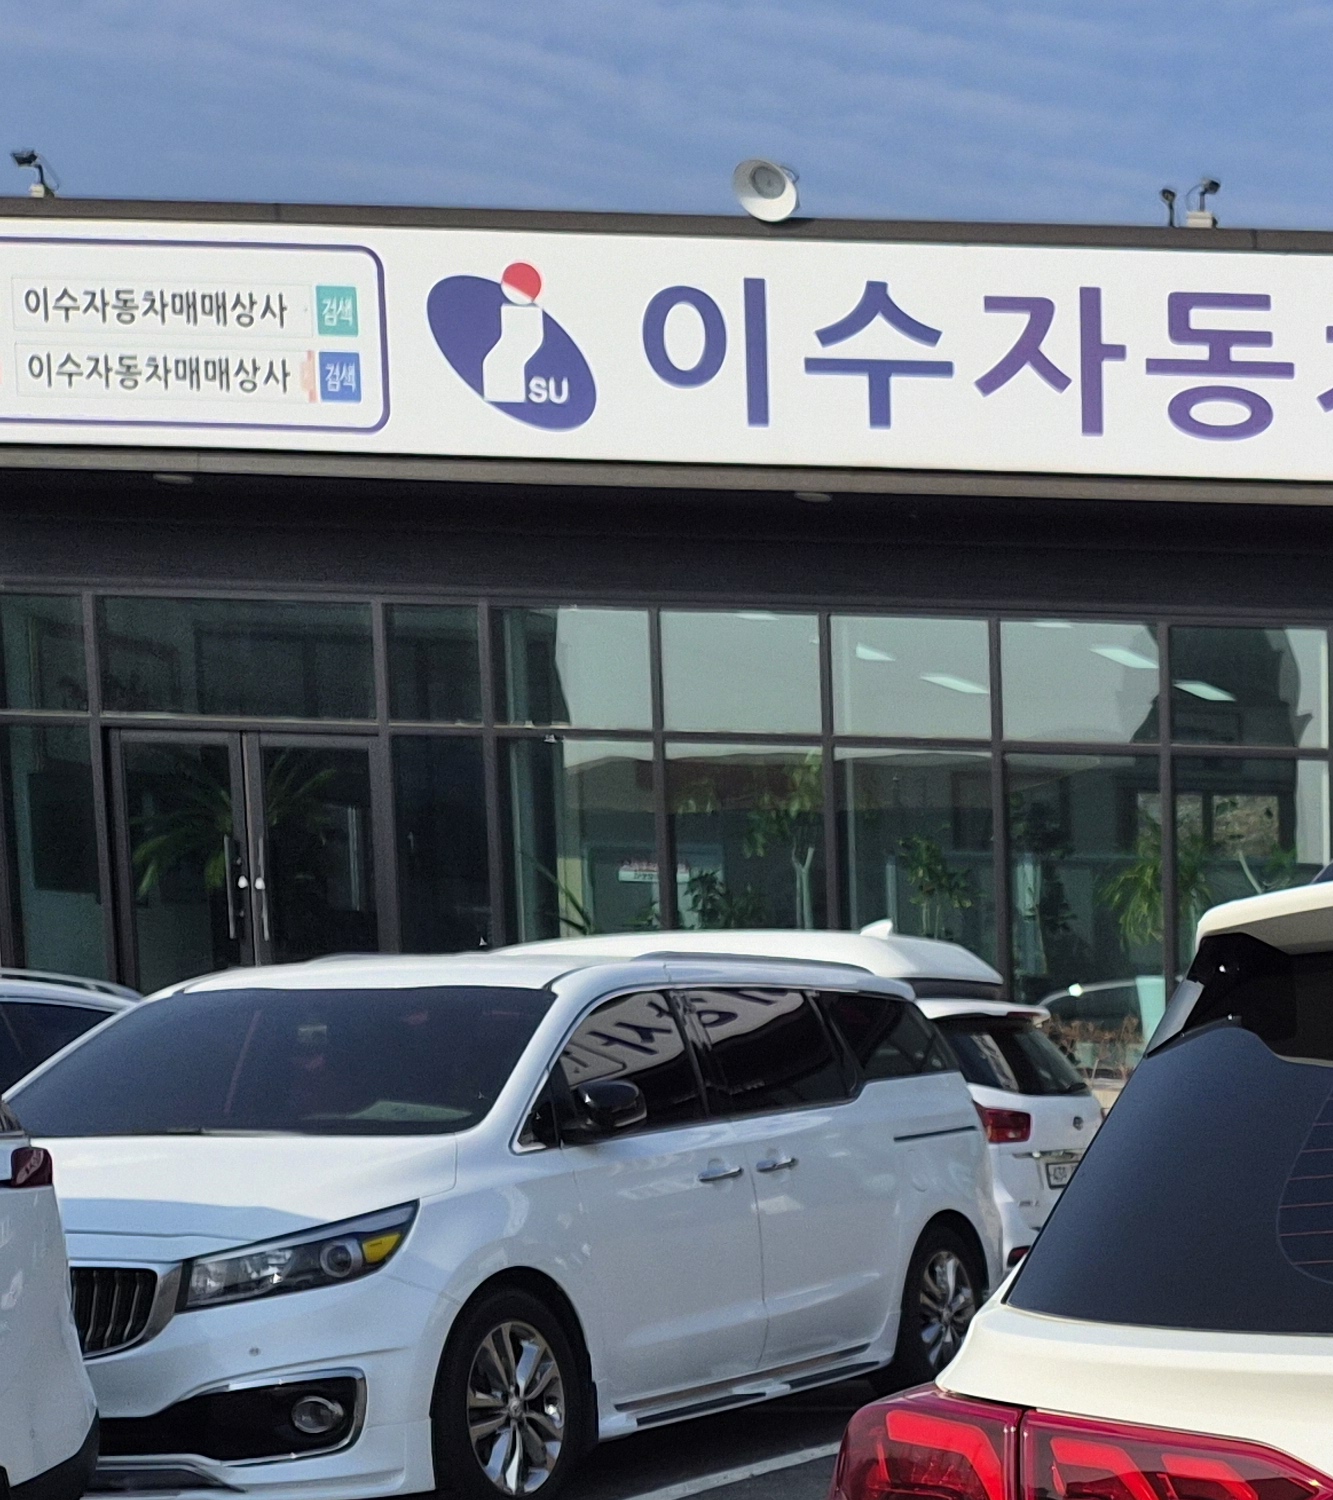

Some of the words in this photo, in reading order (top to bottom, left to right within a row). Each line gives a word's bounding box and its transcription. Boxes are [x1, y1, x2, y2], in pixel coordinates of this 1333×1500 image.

[24, 287, 288, 329] 이수자동차매매상사
[322, 296, 354, 327] 검색
[28, 352, 291, 394] 이수자동차매매상사
[325, 362, 356, 392] 검색
[528, 376, 568, 404] SU
